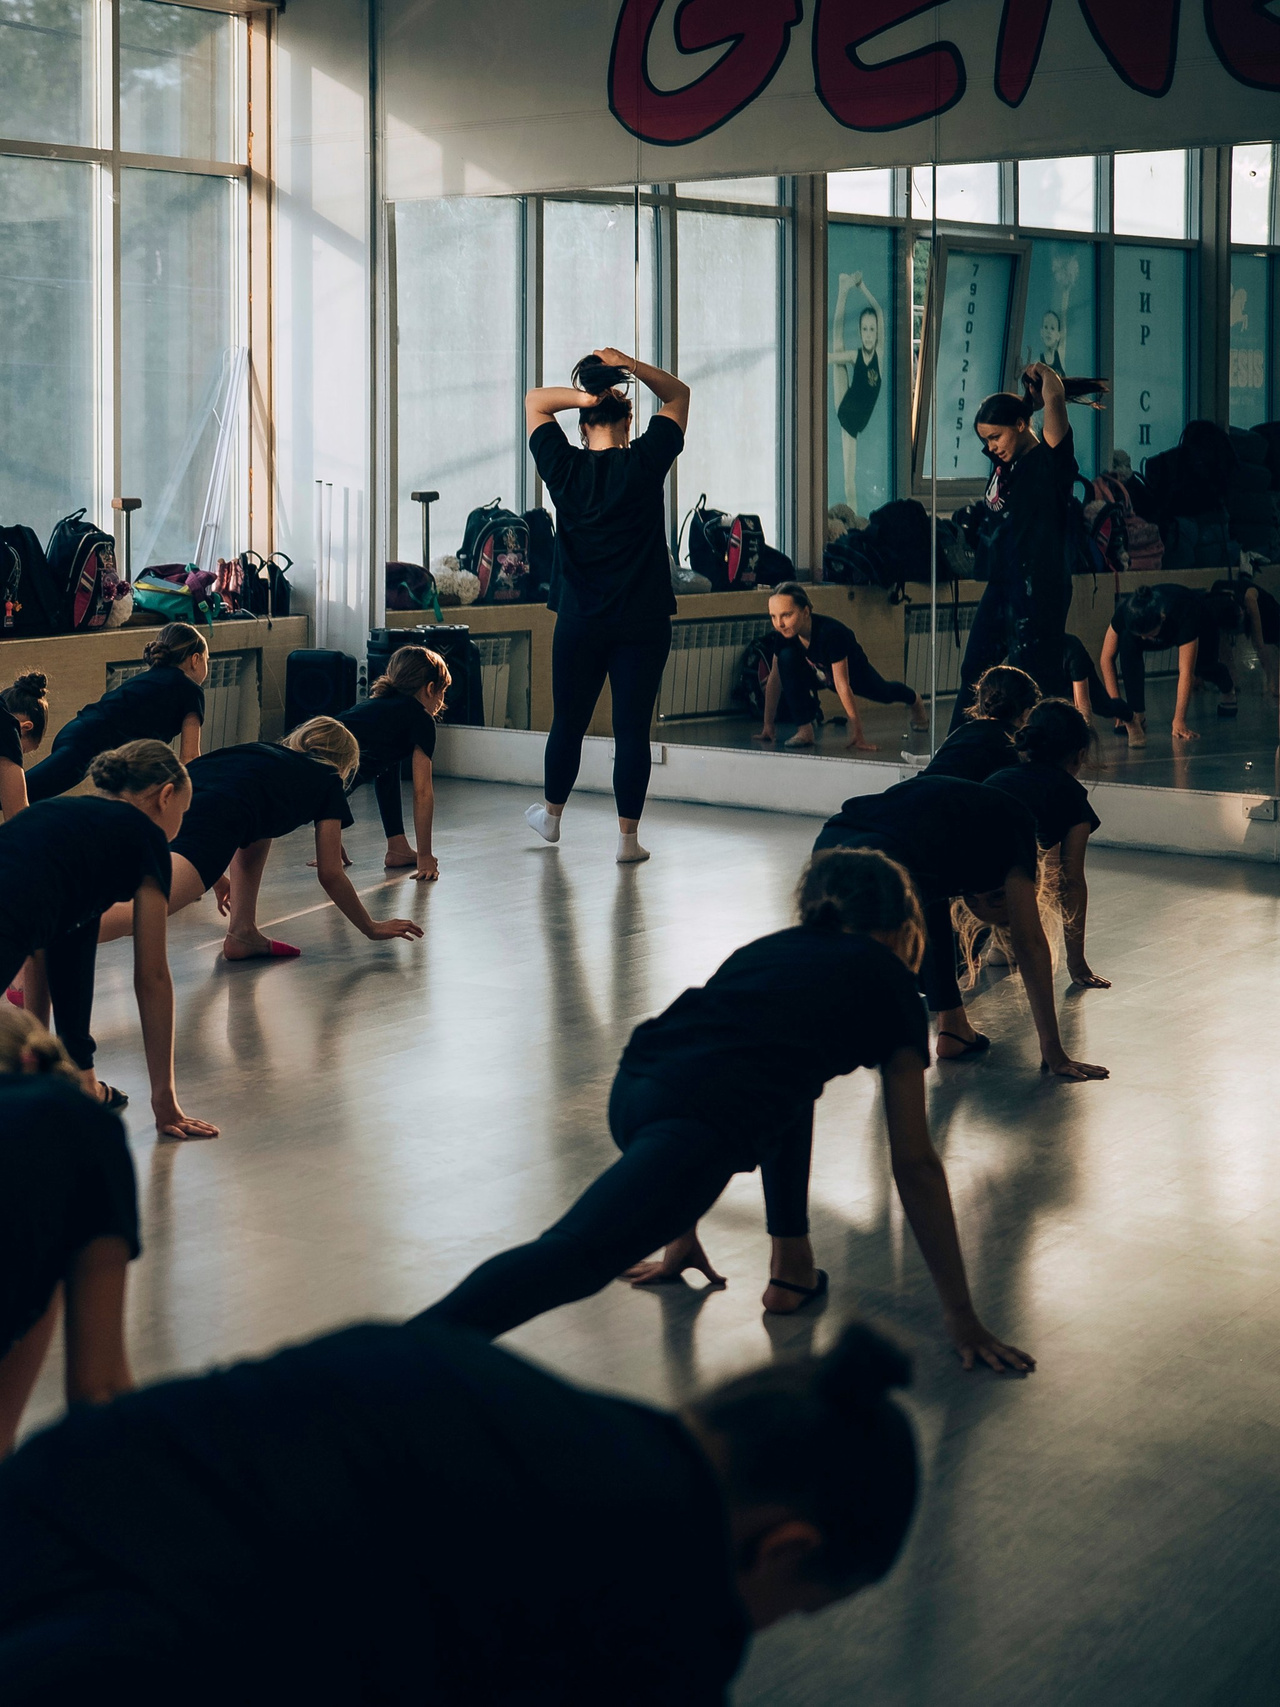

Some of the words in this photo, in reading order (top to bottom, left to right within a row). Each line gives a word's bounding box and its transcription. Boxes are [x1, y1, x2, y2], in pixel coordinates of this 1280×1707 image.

[1139, 258, 1152, 346] ЧИР
[953, 263, 980, 469] 79001219511
[1229, 348, 1264, 388] ESIS
